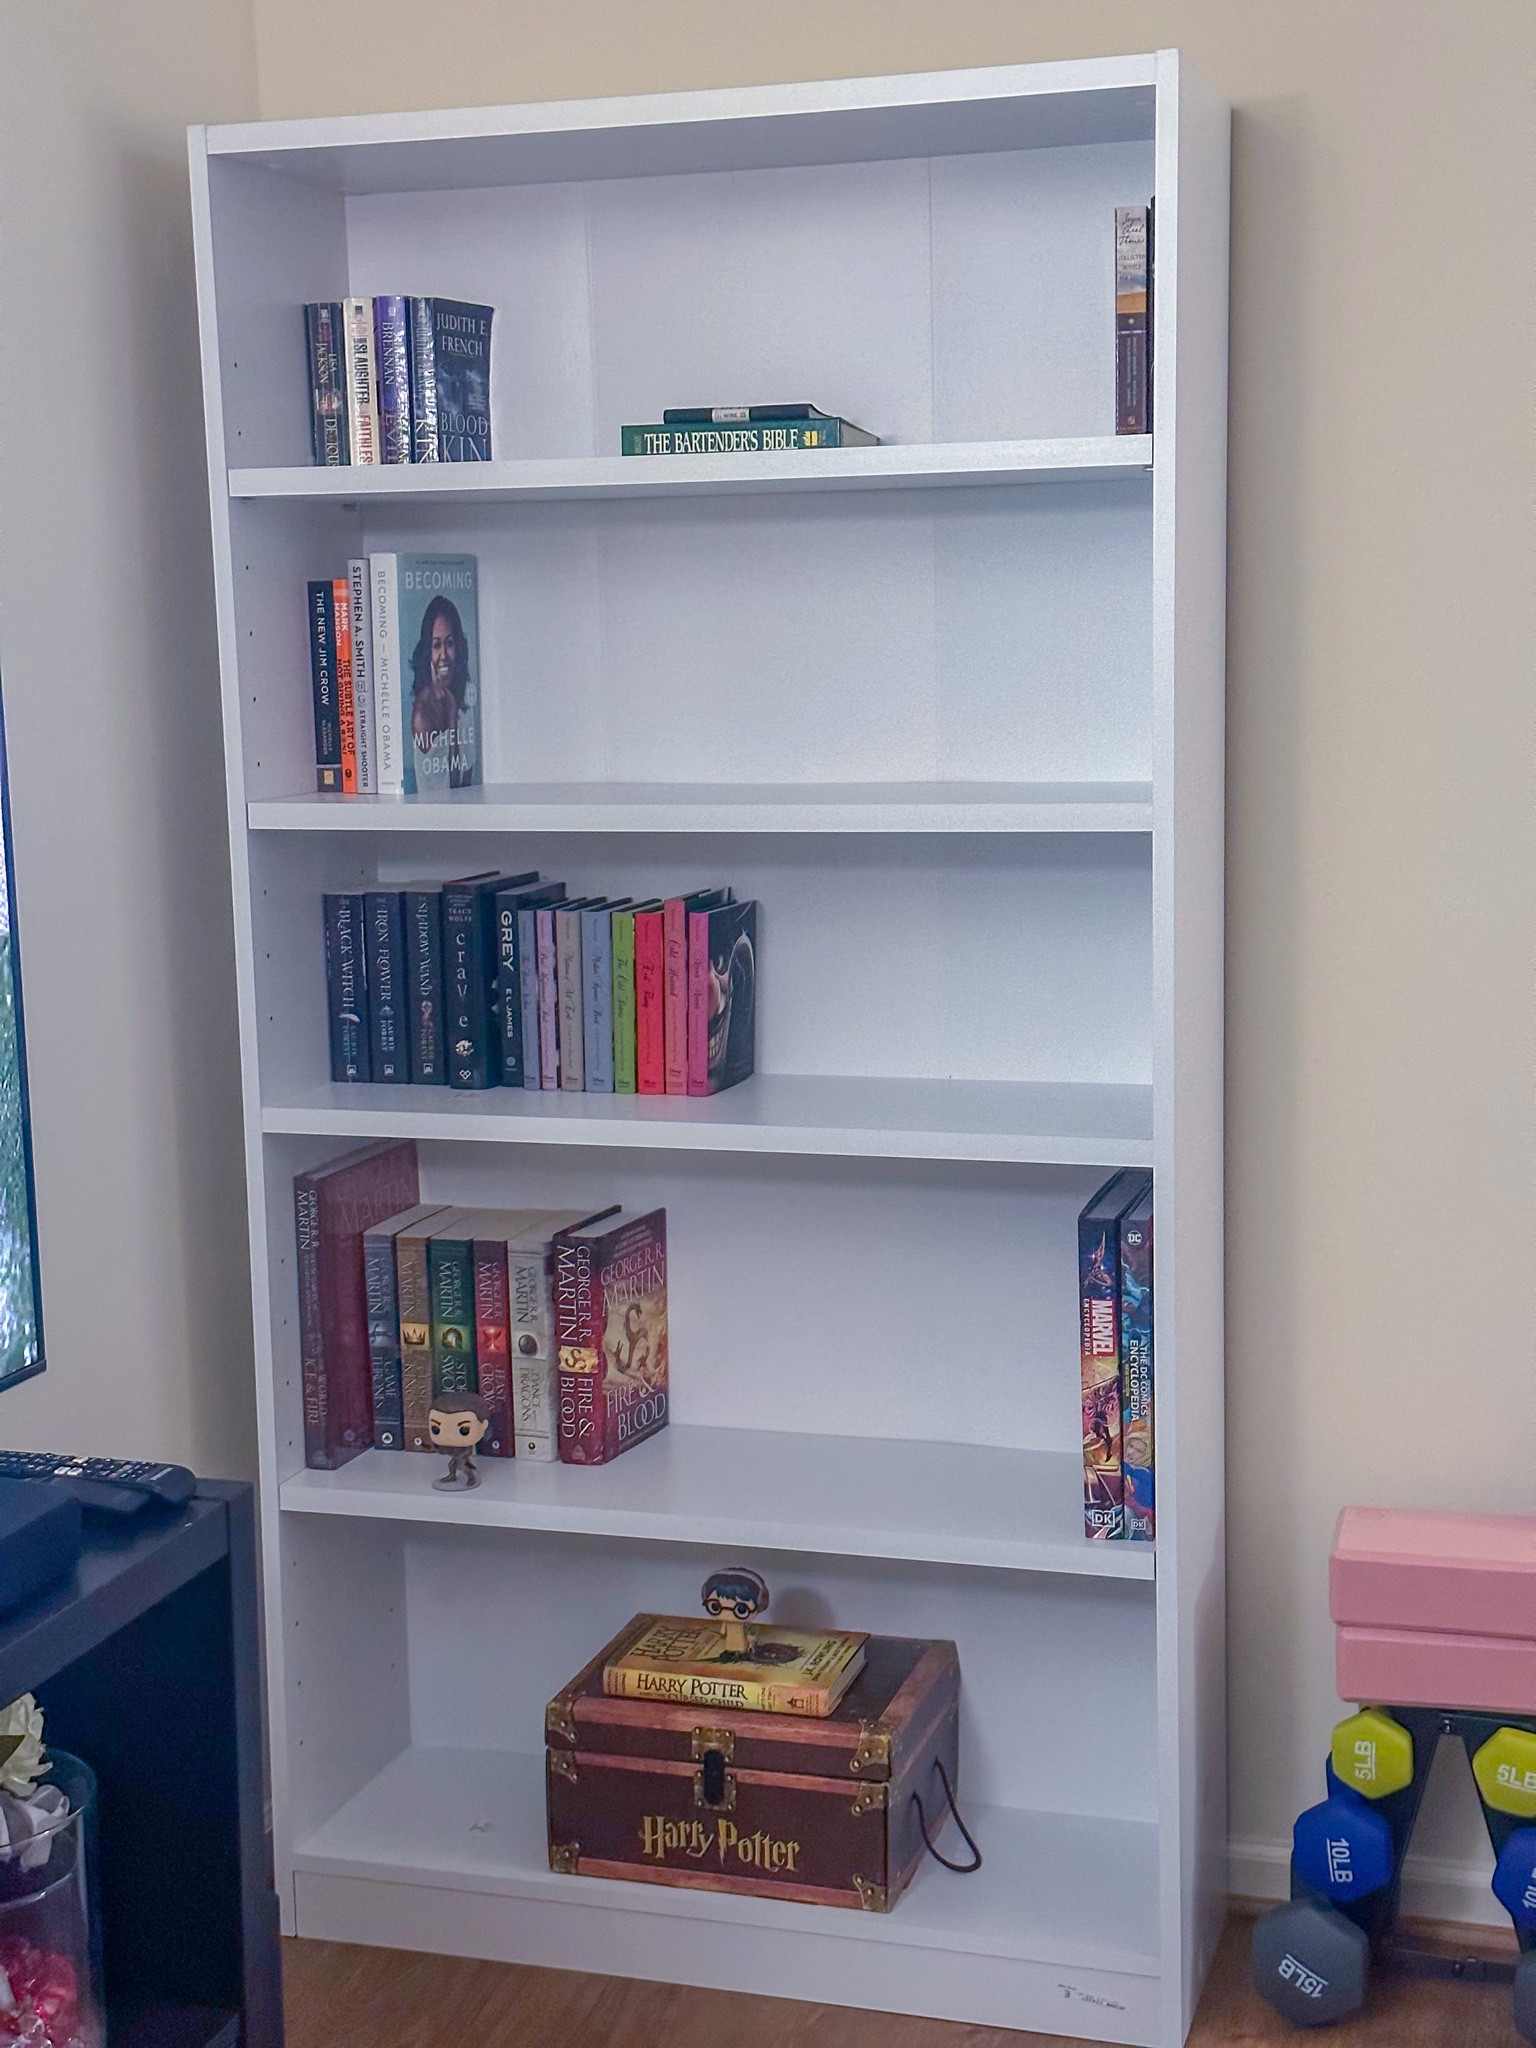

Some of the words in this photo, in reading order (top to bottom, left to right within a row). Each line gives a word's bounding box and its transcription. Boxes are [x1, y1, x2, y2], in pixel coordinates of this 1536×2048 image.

[436, 312, 476, 334] JUDITH
[316, 343, 330, 384] JACKSON
[382, 322, 396, 385] BRENNAN
[441, 336, 483, 357] FRENCH
[353, 342, 371, 404] SLAUGHTER
[357, 414, 374, 465] FAITHLES
[441, 413, 489, 436] BLOOD
[644, 432, 671, 454] THE
[675, 430, 758, 453] BARTENDER'S
[763, 429, 799, 450] BIBLE
[442, 435, 488, 461] KIN
[353, 566, 364, 628] STEPHEN
[405, 571, 472, 590] BECOMING
[315, 592, 325, 613] THE
[341, 603, 349, 631] MARK
[377, 570, 388, 638] BECOMING
[317, 616, 327, 646] NEW
[334, 603, 342, 647] MANSON
[354, 624, 364, 637] A.
[319, 649, 329, 667] JIM
[343, 659, 351, 678] THE
[355, 640, 366, 678] SMITH
[320, 671, 330, 706] CROW
[344, 680, 353, 716] SUBTLE
[380, 657, 390, 718] MICHELLE
[346, 719, 355, 740] ART
[348, 742, 356, 755] OF
[359, 709, 367, 749] STRAIGHT
[382, 725, 392, 771] OBAMA
[413, 727, 474, 750] MICHELLE
[361, 751, 369, 788] SHOOTER
[423, 755, 469, 776] OBAMA
[337, 909, 352, 954] BLACK
[375, 909, 389, 943] IRON
[501, 911, 515, 972] GREY
[341, 958, 354, 1008] WITCH
[376, 948, 391, 1001] FLOWER
[506, 1005, 514, 1038] JAMES
[297, 1191, 310, 1250] MARTIN
[1128, 1232, 1142, 1244] DC
[366, 1257, 382, 1314] MARTIN
[400, 1260, 416, 1317] MARTIN
[577, 1245, 591, 1309] GEORGE
[600, 1251, 643, 1286] GEORGE
[439, 1260, 454, 1318] MARTIN
[478, 1262, 494, 1320] MARTIN
[515, 1266, 530, 1323] MARTIN
[557, 1244, 578, 1341] MARTIN
[602, 1261, 665, 1317] MARTIN
[1083, 1298, 1092, 1356] ENCYCLOPEDIA
[1092, 1300, 1114, 1355] MARVEL
[1140, 1346, 1148, 1365] THE
[1140, 1366, 1148, 1380] DC
[577, 1377, 593, 1414] FIRE
[606, 1385, 637, 1418] FIRE
[638, 1376, 656, 1398] &
[1129, 1339, 1140, 1422] ENCYCLOPEDIA
[1140, 1380, 1149, 1416] COMICS
[560, 1376, 577, 1438] BLOOD
[618, 1393, 667, 1441] BLOOD
[578, 1418, 595, 1439] &
[637, 1673, 687, 1693] HARRY
[690, 1678, 749, 1701] POTTER
[1355, 1740, 1373, 1780] 5LB
[638, 1816, 715, 1859] Harry
[717, 1818, 801, 1873] Potter
[1331, 1838, 1353, 1883] 10LB
[1278, 1958, 1324, 1999] 15LB
